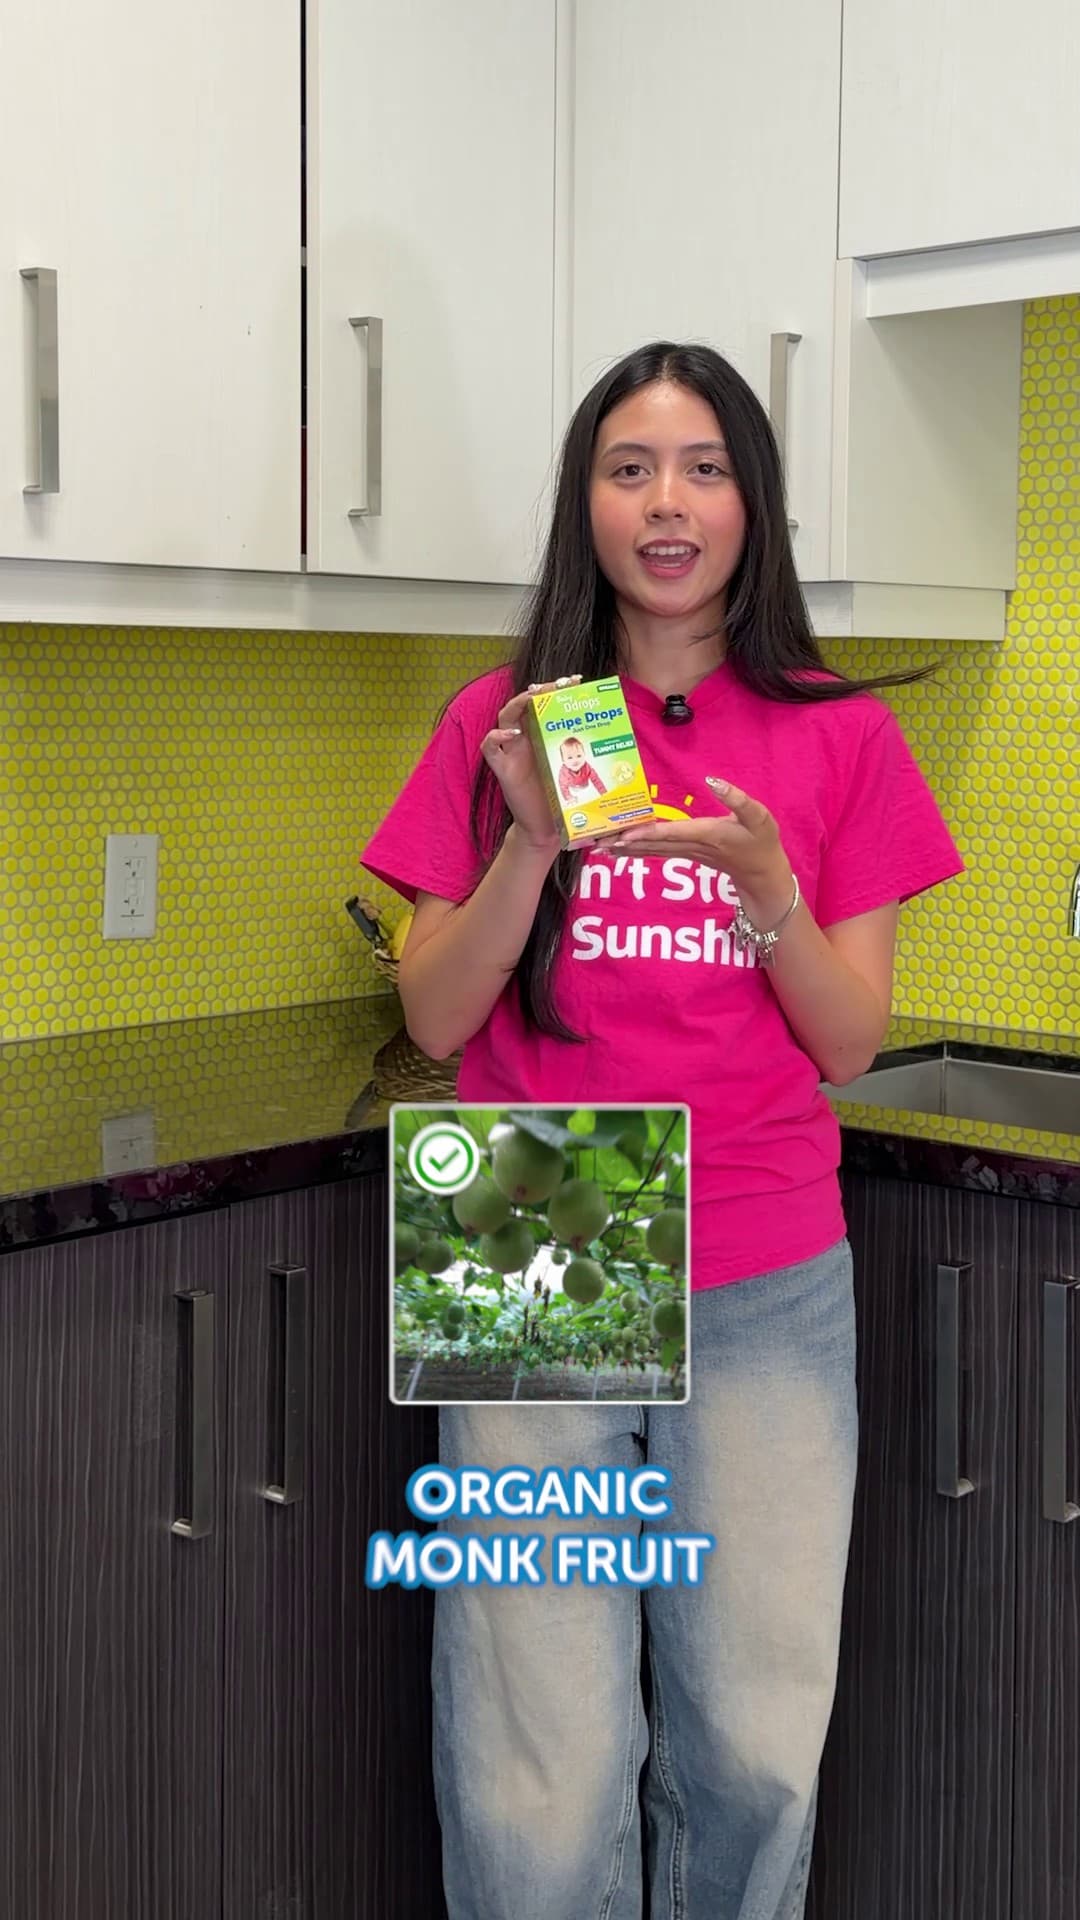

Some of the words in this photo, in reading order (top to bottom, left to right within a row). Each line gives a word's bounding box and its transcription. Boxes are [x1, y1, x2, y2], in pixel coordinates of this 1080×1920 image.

[563, 697, 601, 712] Ddrops
[545, 717, 582, 732] Gripe
[584, 707, 623, 722] Drops
[571, 857, 650, 900] n't
[661, 857, 740, 906] Ste
